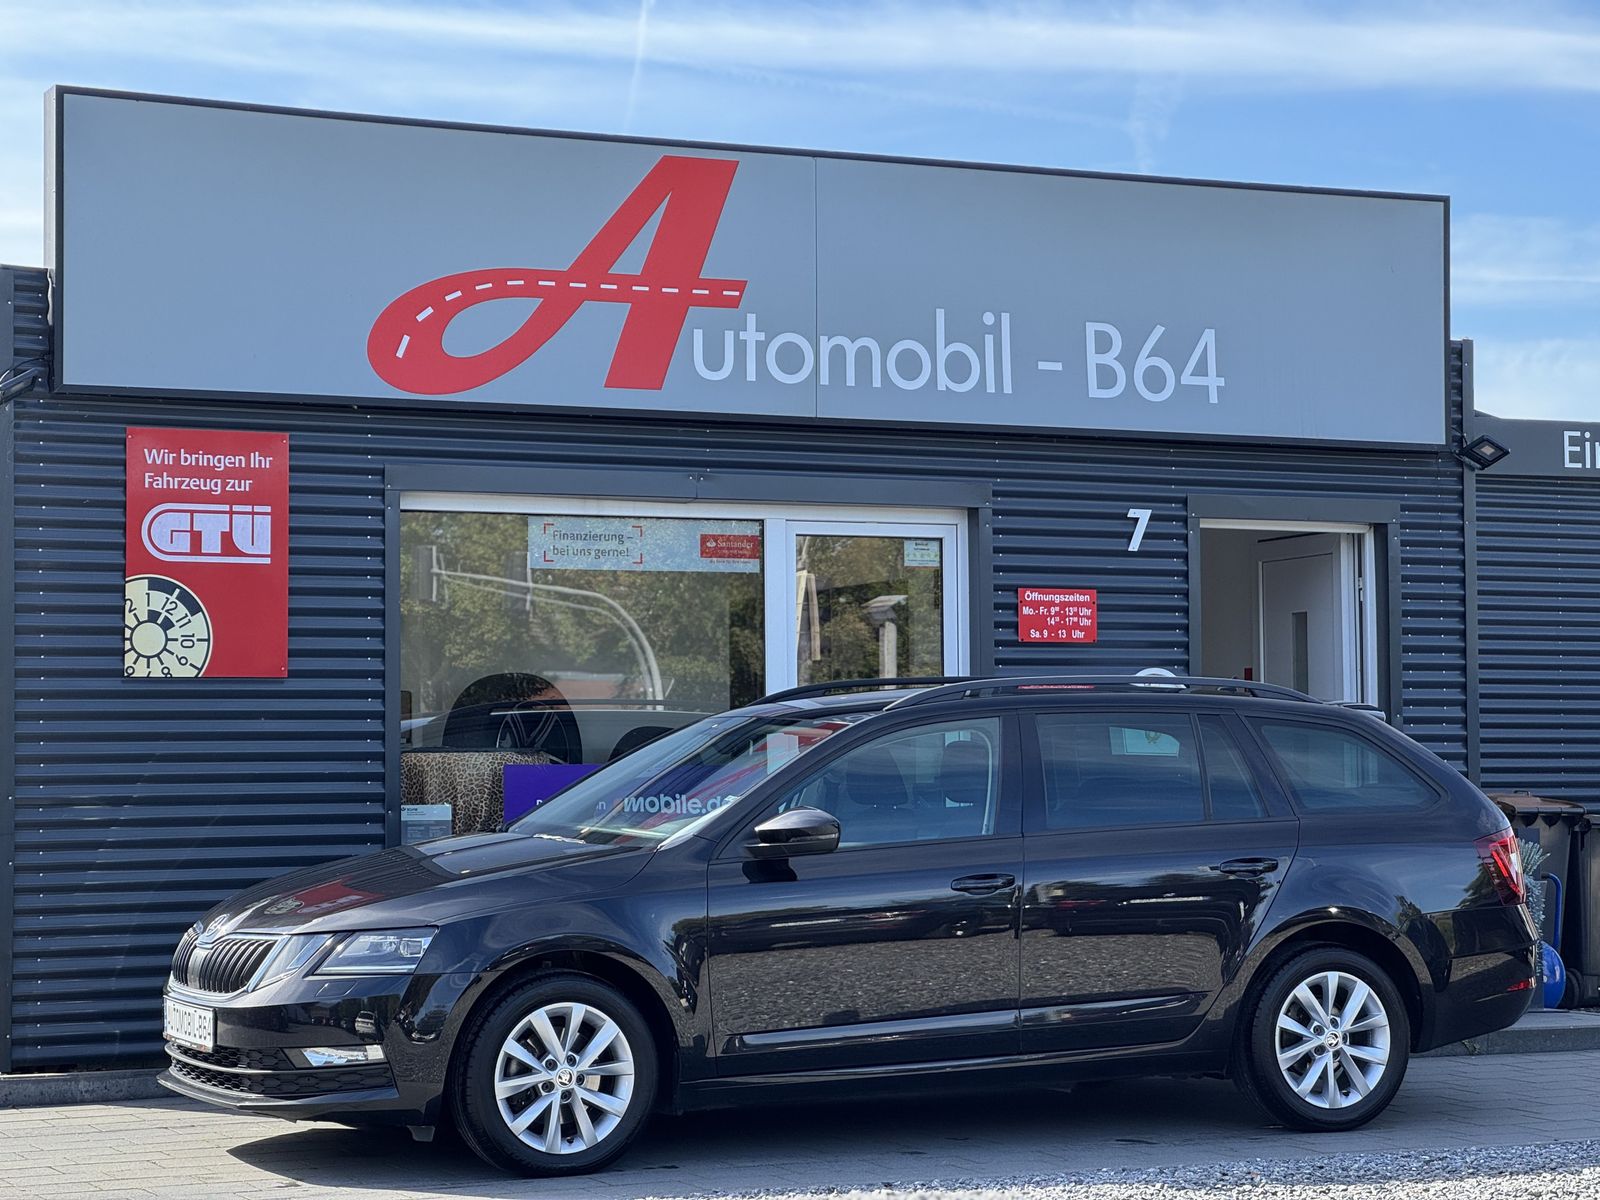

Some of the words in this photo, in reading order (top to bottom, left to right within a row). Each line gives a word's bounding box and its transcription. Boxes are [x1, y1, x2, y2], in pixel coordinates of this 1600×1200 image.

[367, 155, 1013, 396] Automobil
[1085, 321, 1225, 404] B64
[144, 449, 176, 465] Wir
[181, 449, 246, 471] bringen
[251, 452, 273, 468] Ihr
[144, 472, 222, 494] Fahrzeug
[225, 479, 253, 492] zur
[145, 503, 272, 559] GTÜ
[552, 530, 624, 544] Finanzierung
[1127, 508, 1152, 552] 7
[717, 539, 755, 549] Santander
[552, 545, 570, 556] bei
[572, 548, 592, 556] uns
[594, 547, 629, 559] gerne!
[1024, 591, 1090, 603] Öffnungszeiten
[1079, 607, 1092, 615] Uhr
[1079, 617, 1092, 625] Uhr
[1030, 629, 1041, 638] Sa.
[1042, 629, 1048, 638] 9
[1058, 629, 1067, 639] 13
[1072, 629, 1085, 638] Uhr
